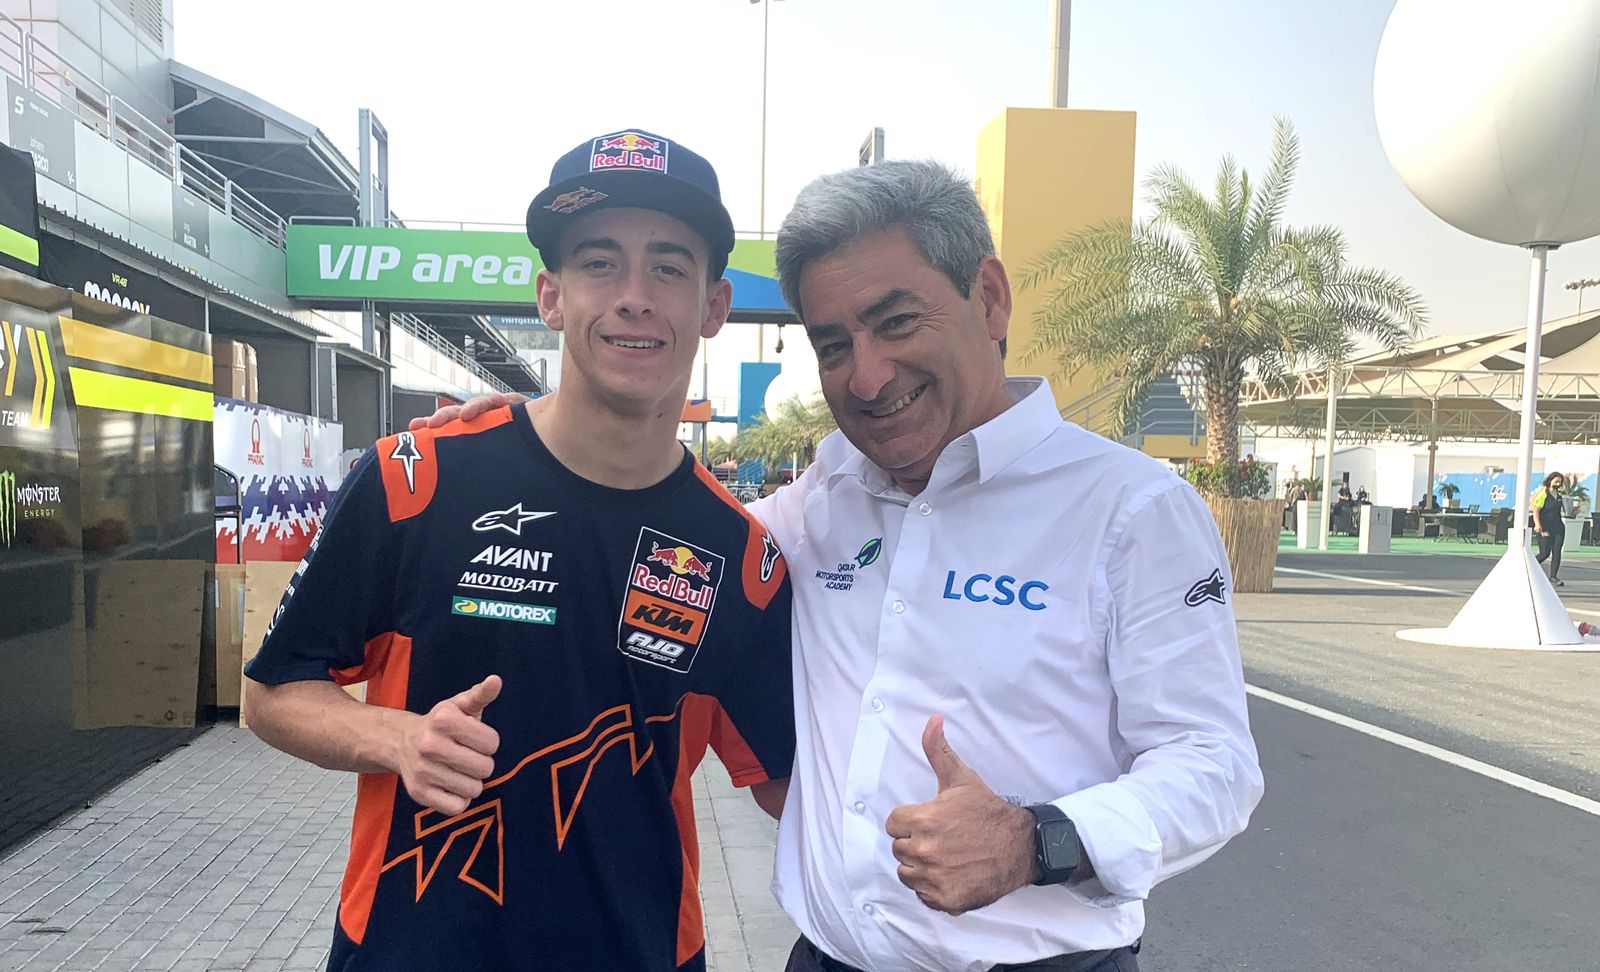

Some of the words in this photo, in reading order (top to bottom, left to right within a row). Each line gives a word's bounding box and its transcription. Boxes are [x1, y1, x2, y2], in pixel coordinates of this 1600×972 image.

[593, 151, 628, 168] Red
[630, 152, 665, 171] Bull
[318, 244, 401, 281] VIP
[412, 253, 533, 285] area
[111, 272, 128, 288] VR46
[2, 410, 29, 427] TEAM
[17, 483, 61, 506] MONSTER
[24, 509, 55, 519] ENERGY
[470, 545, 553, 572] AVANT
[457, 571, 559, 593] MOTOBATT
[632, 563, 677, 597] Red
[673, 577, 713, 610] Bull
[815, 570, 854, 583] MOTORSPORTS
[824, 581, 853, 592] ACADEMY
[943, 570, 1049, 611] LCSC
[479, 602, 553, 623] MOTOREX
[631, 603, 694, 635] KTM
[626, 631, 685, 658] AJO
